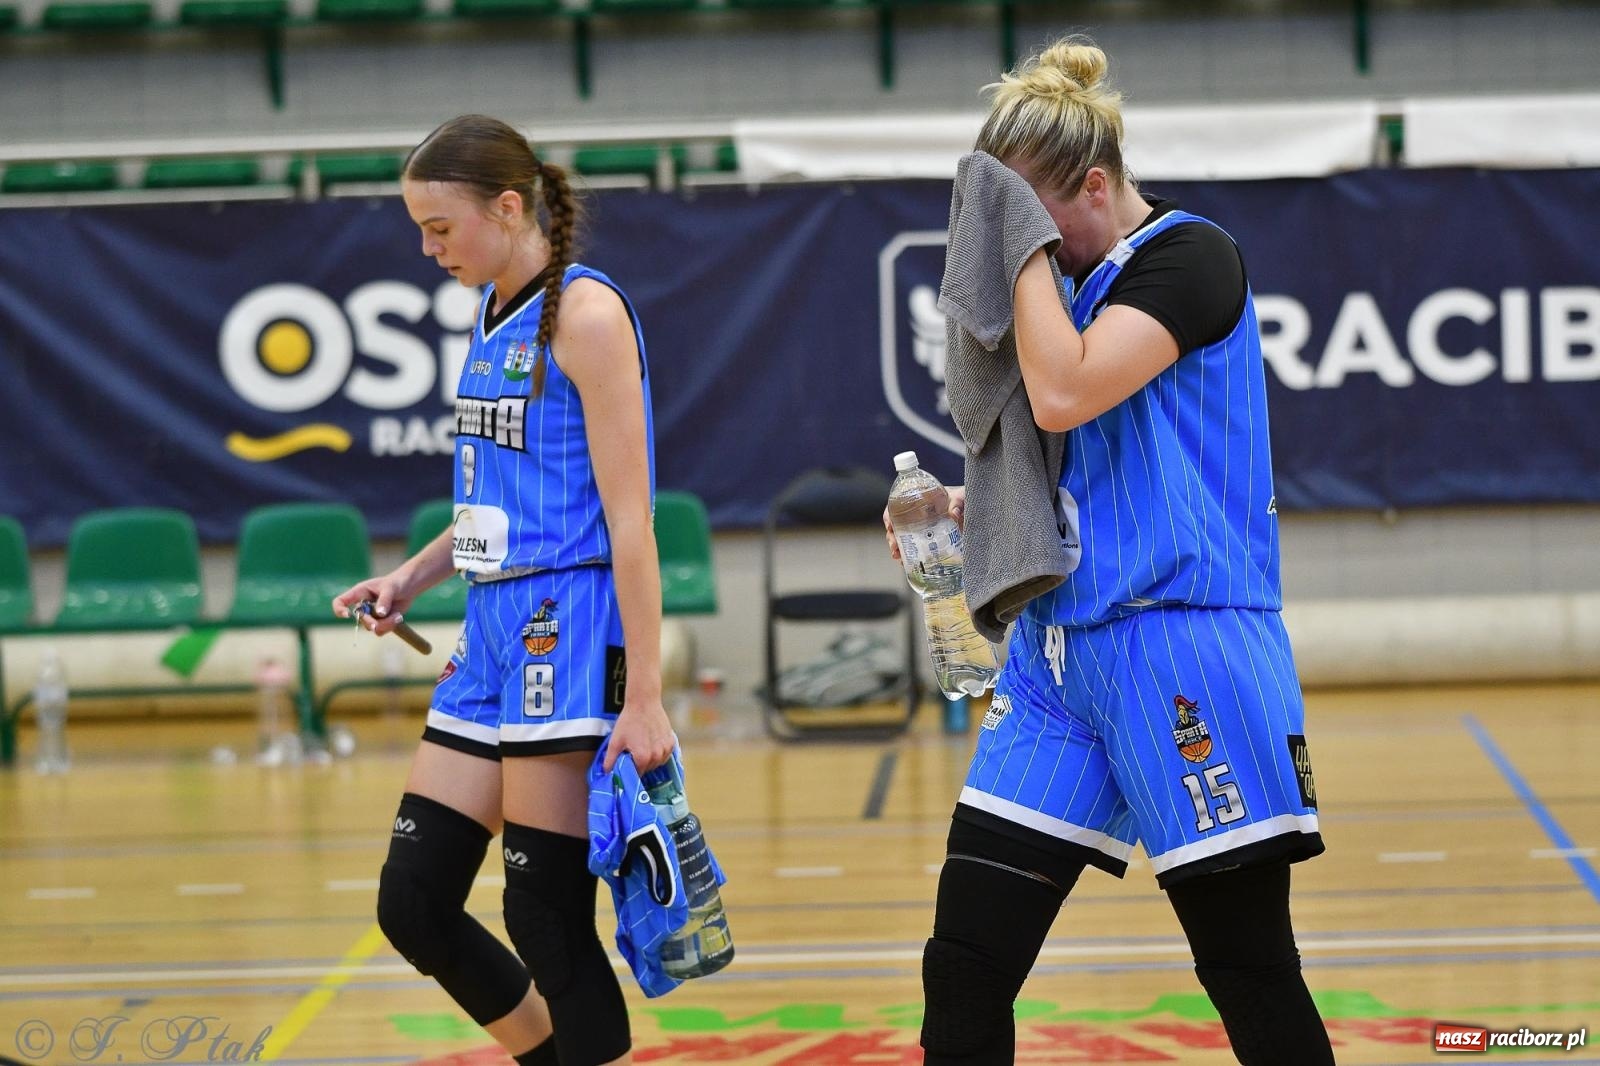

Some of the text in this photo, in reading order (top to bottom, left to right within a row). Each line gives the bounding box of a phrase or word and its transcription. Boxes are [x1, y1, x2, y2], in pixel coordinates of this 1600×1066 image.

[1253, 287, 1600, 391] RACIB
[524, 663, 554, 717] 8
[1181, 763, 1246, 832] 15
